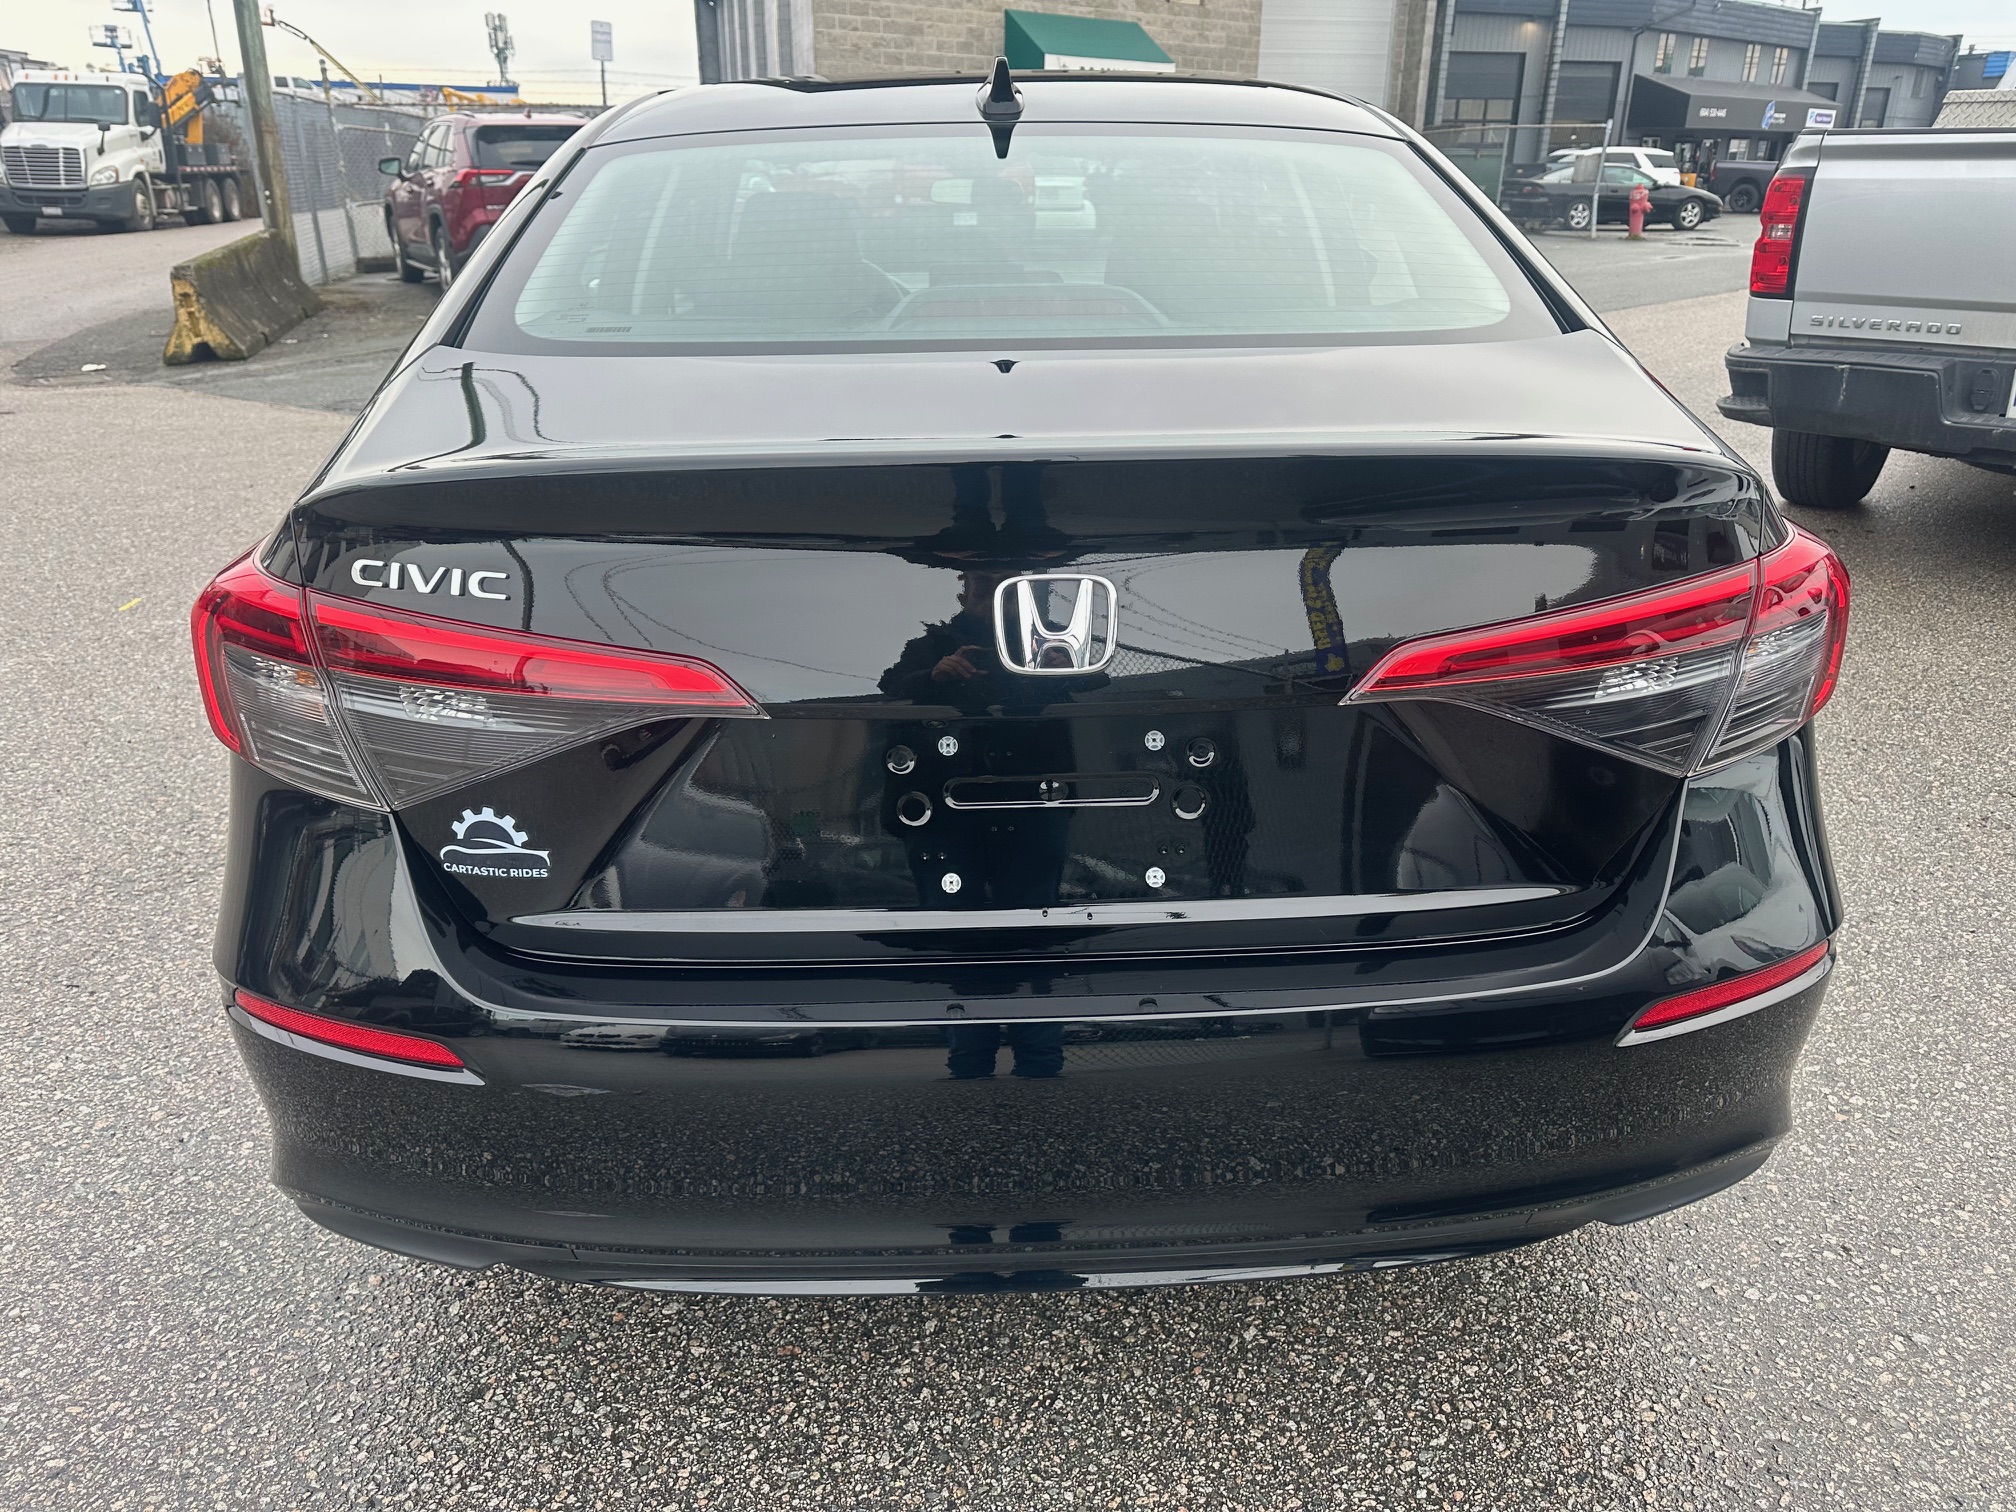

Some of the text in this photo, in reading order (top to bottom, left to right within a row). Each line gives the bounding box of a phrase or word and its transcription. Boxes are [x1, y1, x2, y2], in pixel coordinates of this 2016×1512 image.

[1810, 314, 1963, 335] SILVERADO
[350, 558, 511, 600] CIVIC
[443, 862, 548, 878] CARTASTIC RIDES
